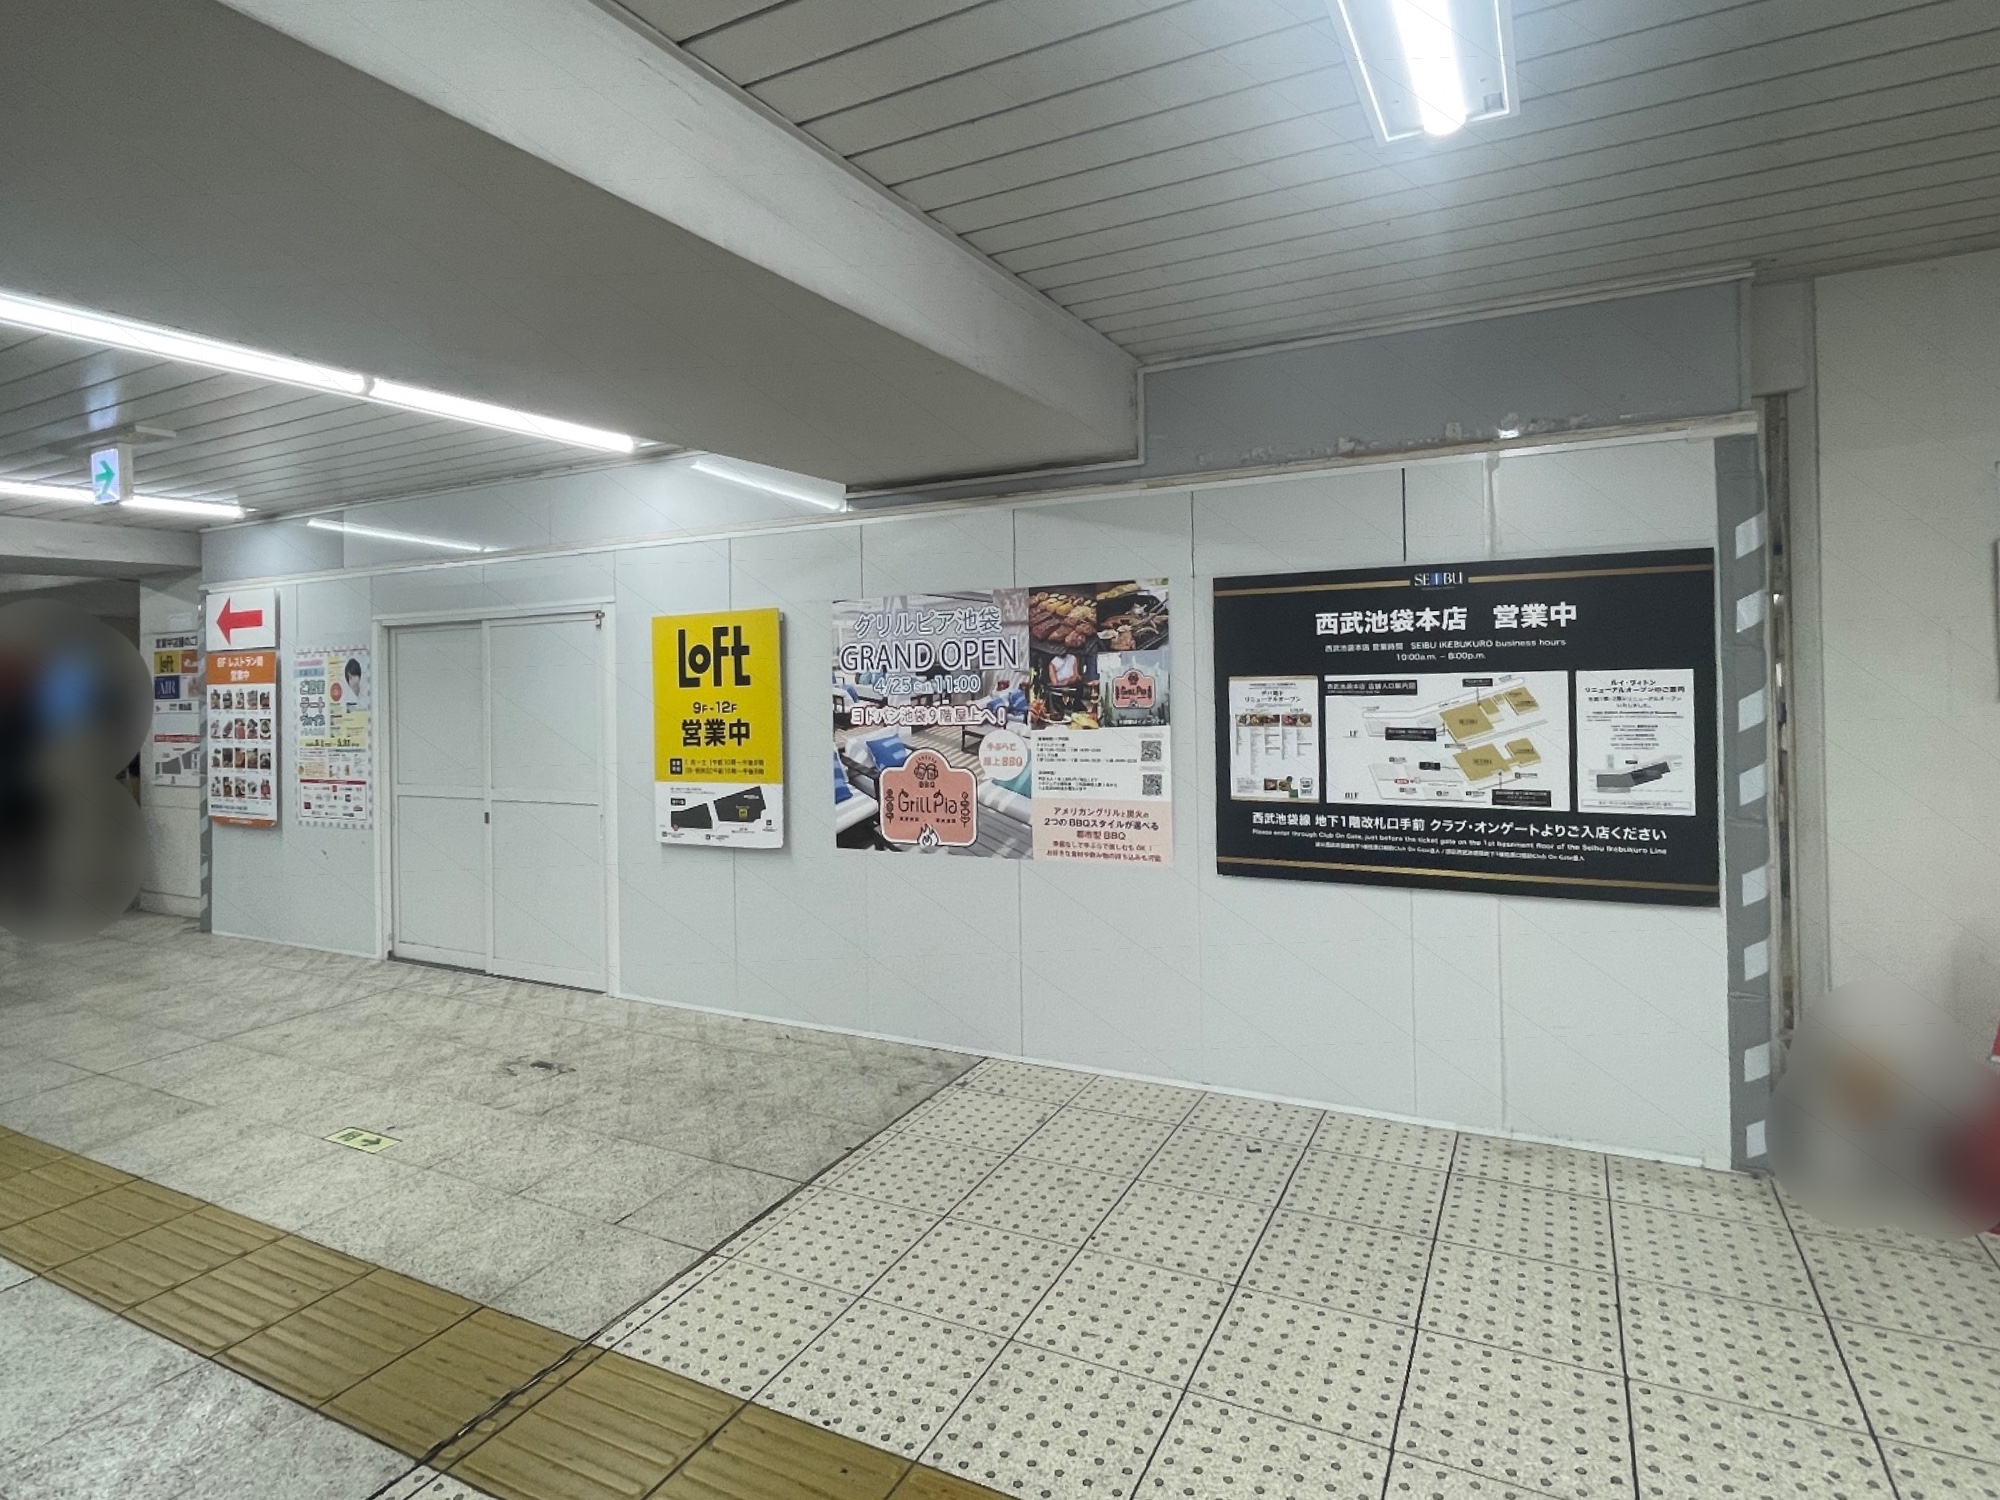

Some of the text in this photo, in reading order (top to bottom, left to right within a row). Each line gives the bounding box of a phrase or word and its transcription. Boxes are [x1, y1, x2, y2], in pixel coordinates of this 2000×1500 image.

[1414, 572, 1463, 586] SEIBU
[855, 606, 1003, 638] グリルピア池袋
[1315, 601, 1577, 635] 西武池袋本店 営業中
[840, 635, 1019, 672] GRAND OPEN
[1410, 641, 1437, 650] SEIBU
[1439, 639, 1493, 649] IKEBUKURO
[1495, 639, 1537, 648] business
[1539, 639, 1567, 647] hours
[873, 678, 912, 696] 4/25
[935, 675, 981, 692] 11:00
[682, 718, 750, 747] 営業中
[898, 789, 957, 814] Grill Pia
[1252, 812, 1310, 826] 西武池袋線
[1291, 831, 1317, 839] through
